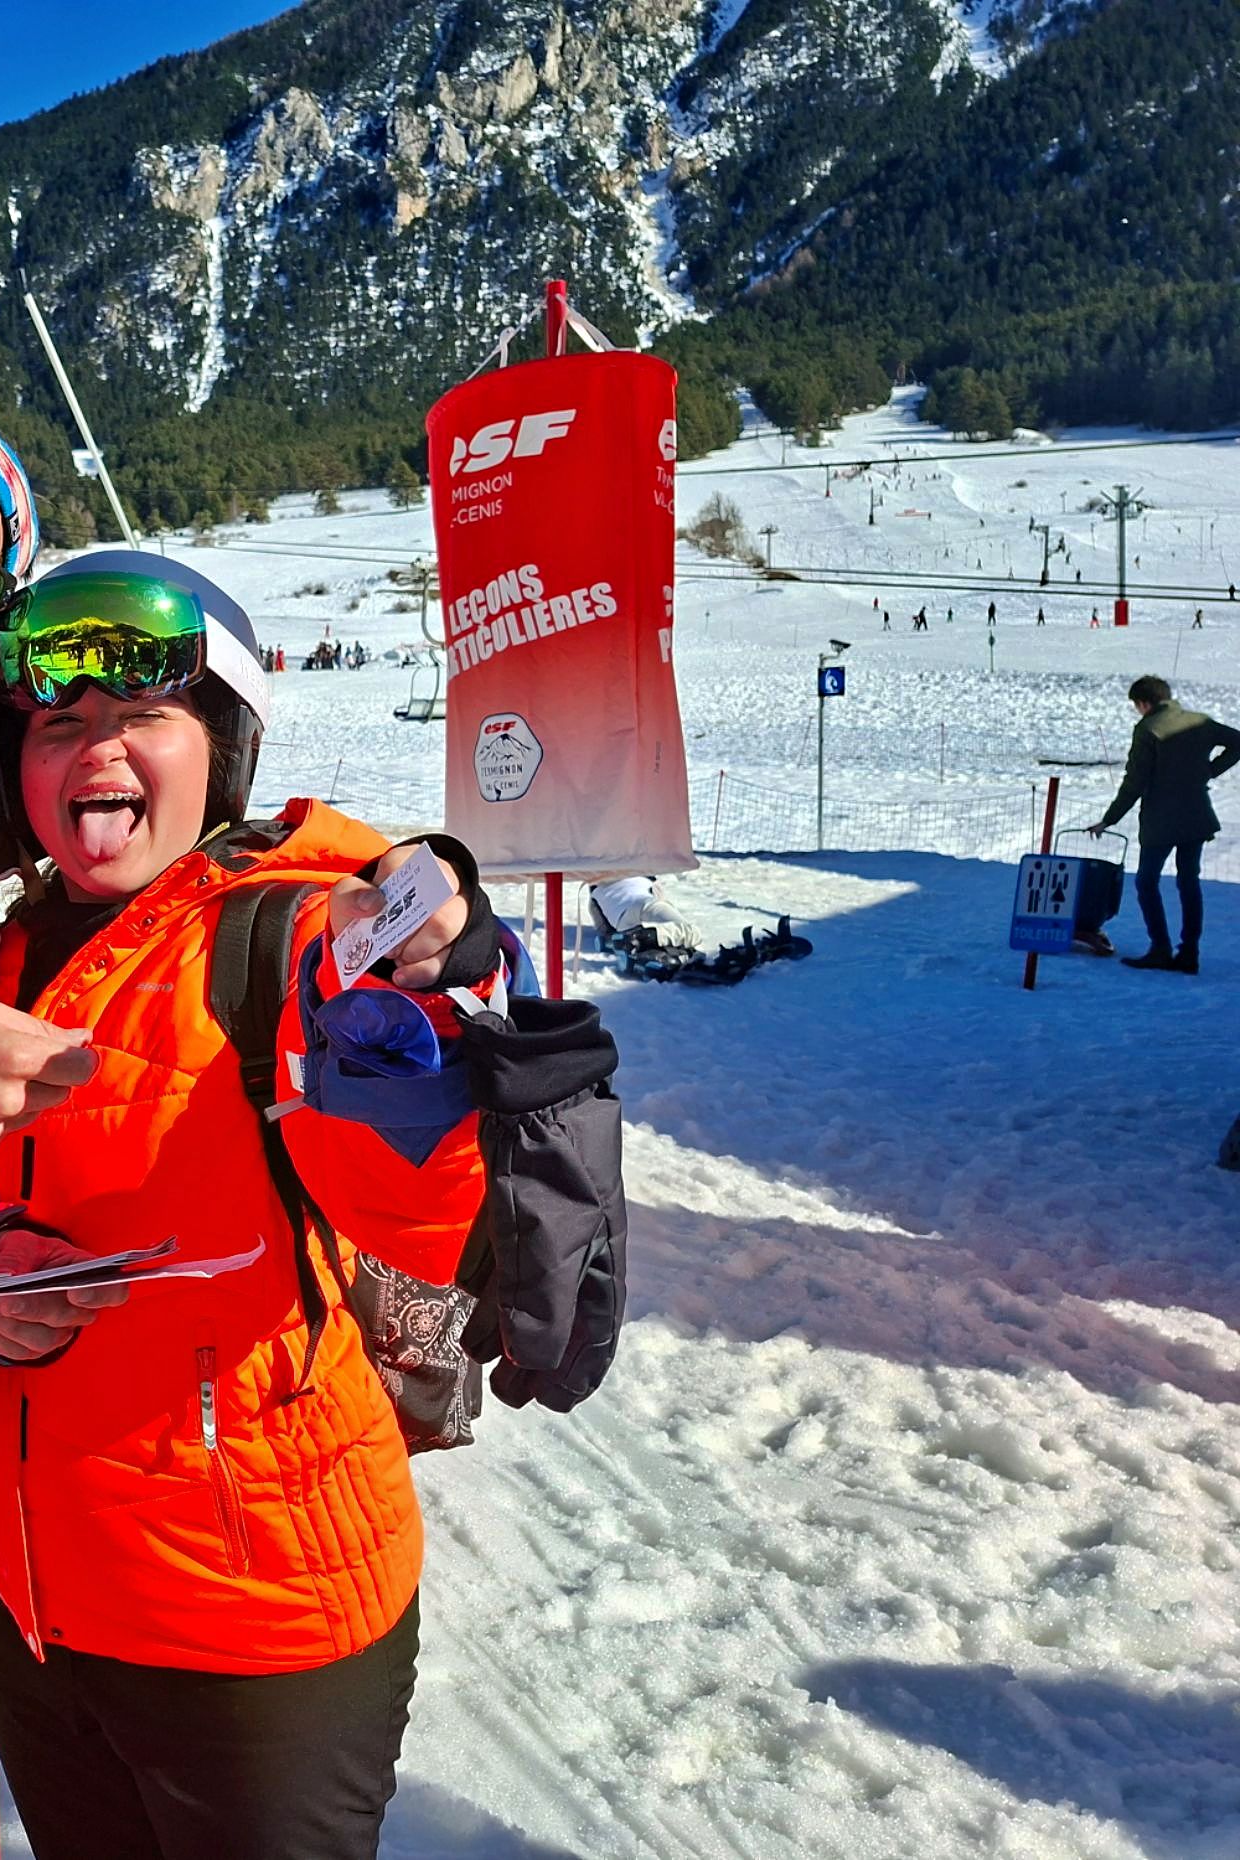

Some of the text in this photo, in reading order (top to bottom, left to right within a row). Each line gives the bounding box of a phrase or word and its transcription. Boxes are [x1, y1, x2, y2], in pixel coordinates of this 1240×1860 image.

[451, 471, 513, 504] MIGNON
[450, 498, 503, 528] -CENIS
[448, 564, 544, 637] LEÇONS
